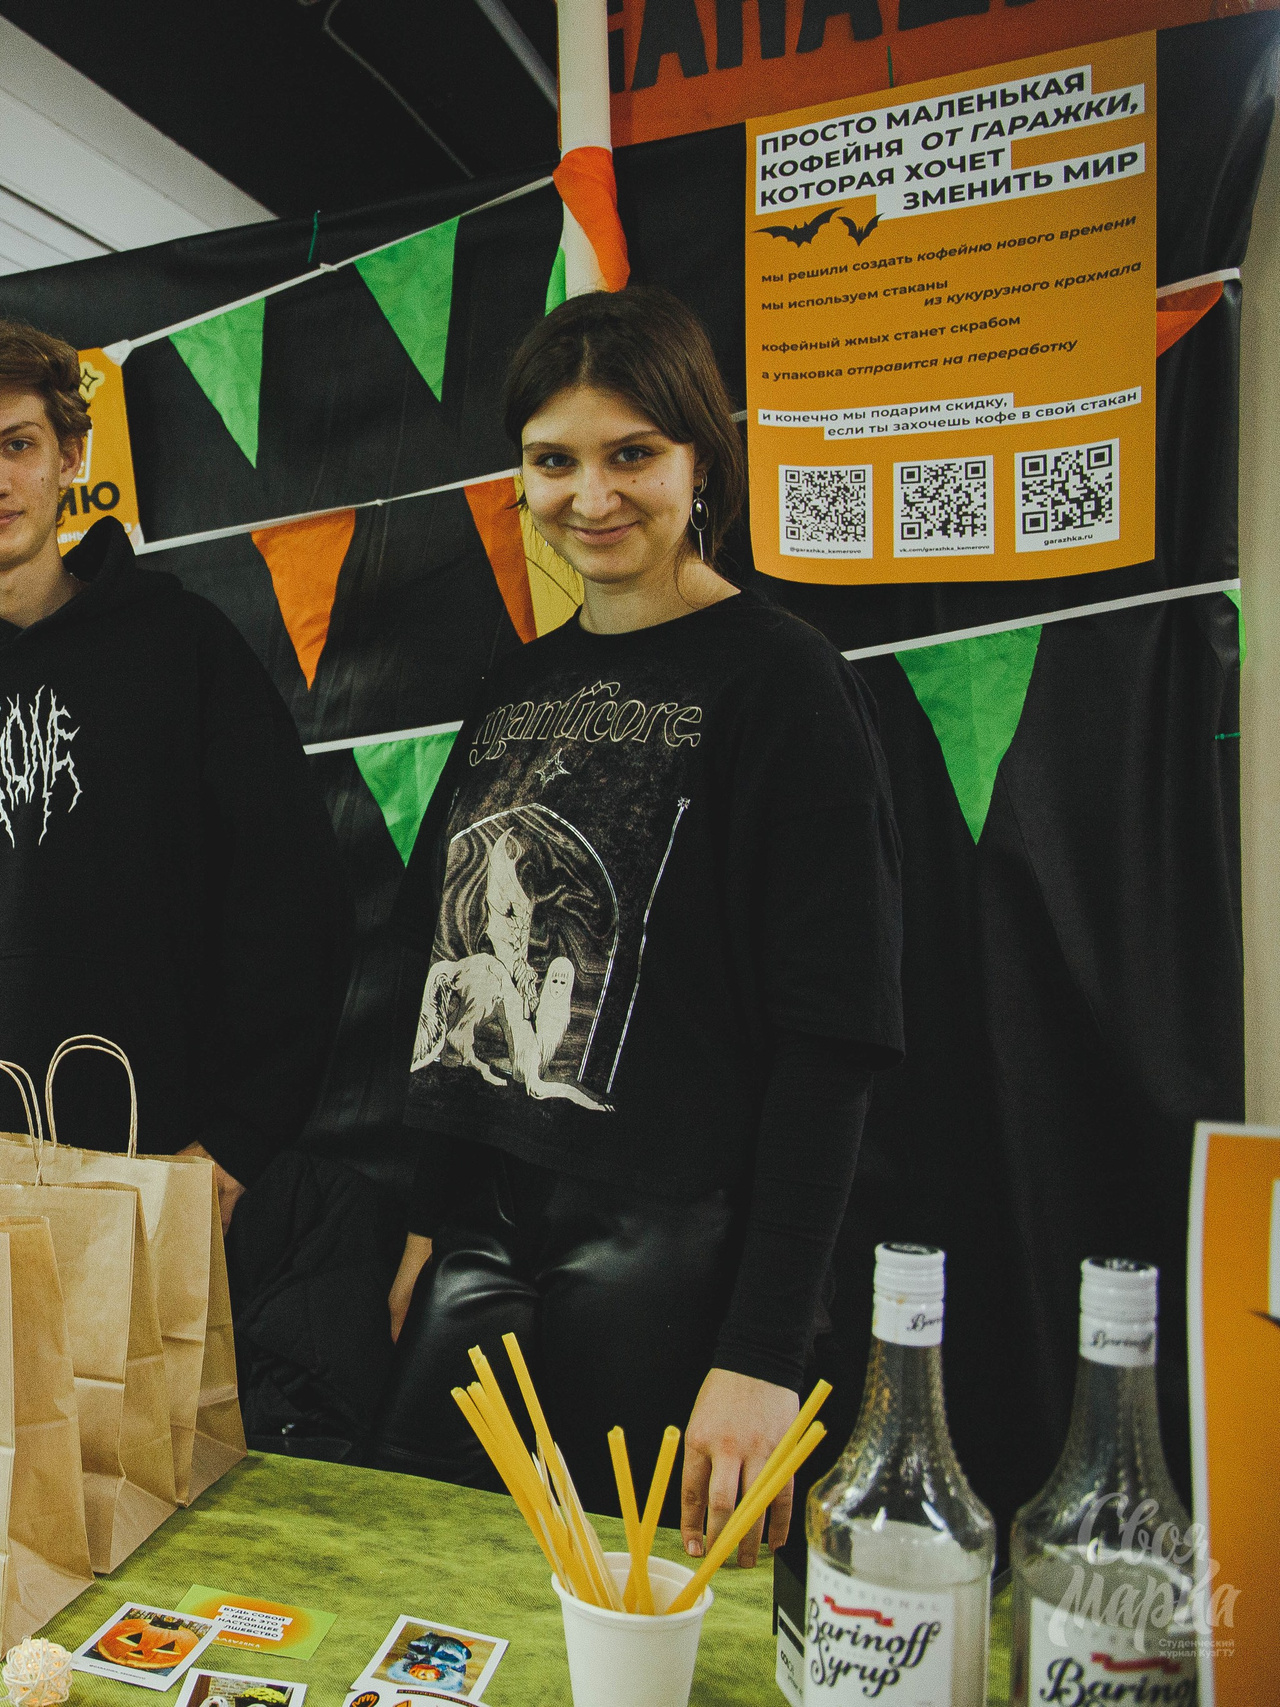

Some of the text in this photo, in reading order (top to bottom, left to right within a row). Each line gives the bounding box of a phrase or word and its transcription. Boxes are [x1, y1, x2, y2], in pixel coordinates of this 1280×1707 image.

[760, 71, 1085, 156] ПРОСТО МАЛЕНЬКАЯ
[760, 91, 1139, 181] КОФЕЙНЯ ОТ ГАРАЖКИ,
[760, 148, 1006, 208] КОТОРАЯ ХОЧЕТ
[902, 150, 1139, 211] ЗМЕНИТЬ МИР
[761, 215, 1137, 284] мы решили создать кофейню нового времени
[761, 278, 949, 312] мы используем стаканы
[923, 261, 1142, 308] из кукурузного крахмала
[761, 313, 1021, 354] кофейный жмых станет скрабом
[761, 337, 1078, 383] а упаковка отправится на переработку
[762, 395, 1008, 424] и конечно мы подарим скидку,
[827, 391, 1138, 437] если ты захочешь кофе в свой стакан
[1043, 532, 1094, 546] garazhka.ru
[259, 1618, 279, 1626] ЭТО
[808, 1597, 942, 1668] Barinoff
[811, 1639, 901, 1698] Syrup
